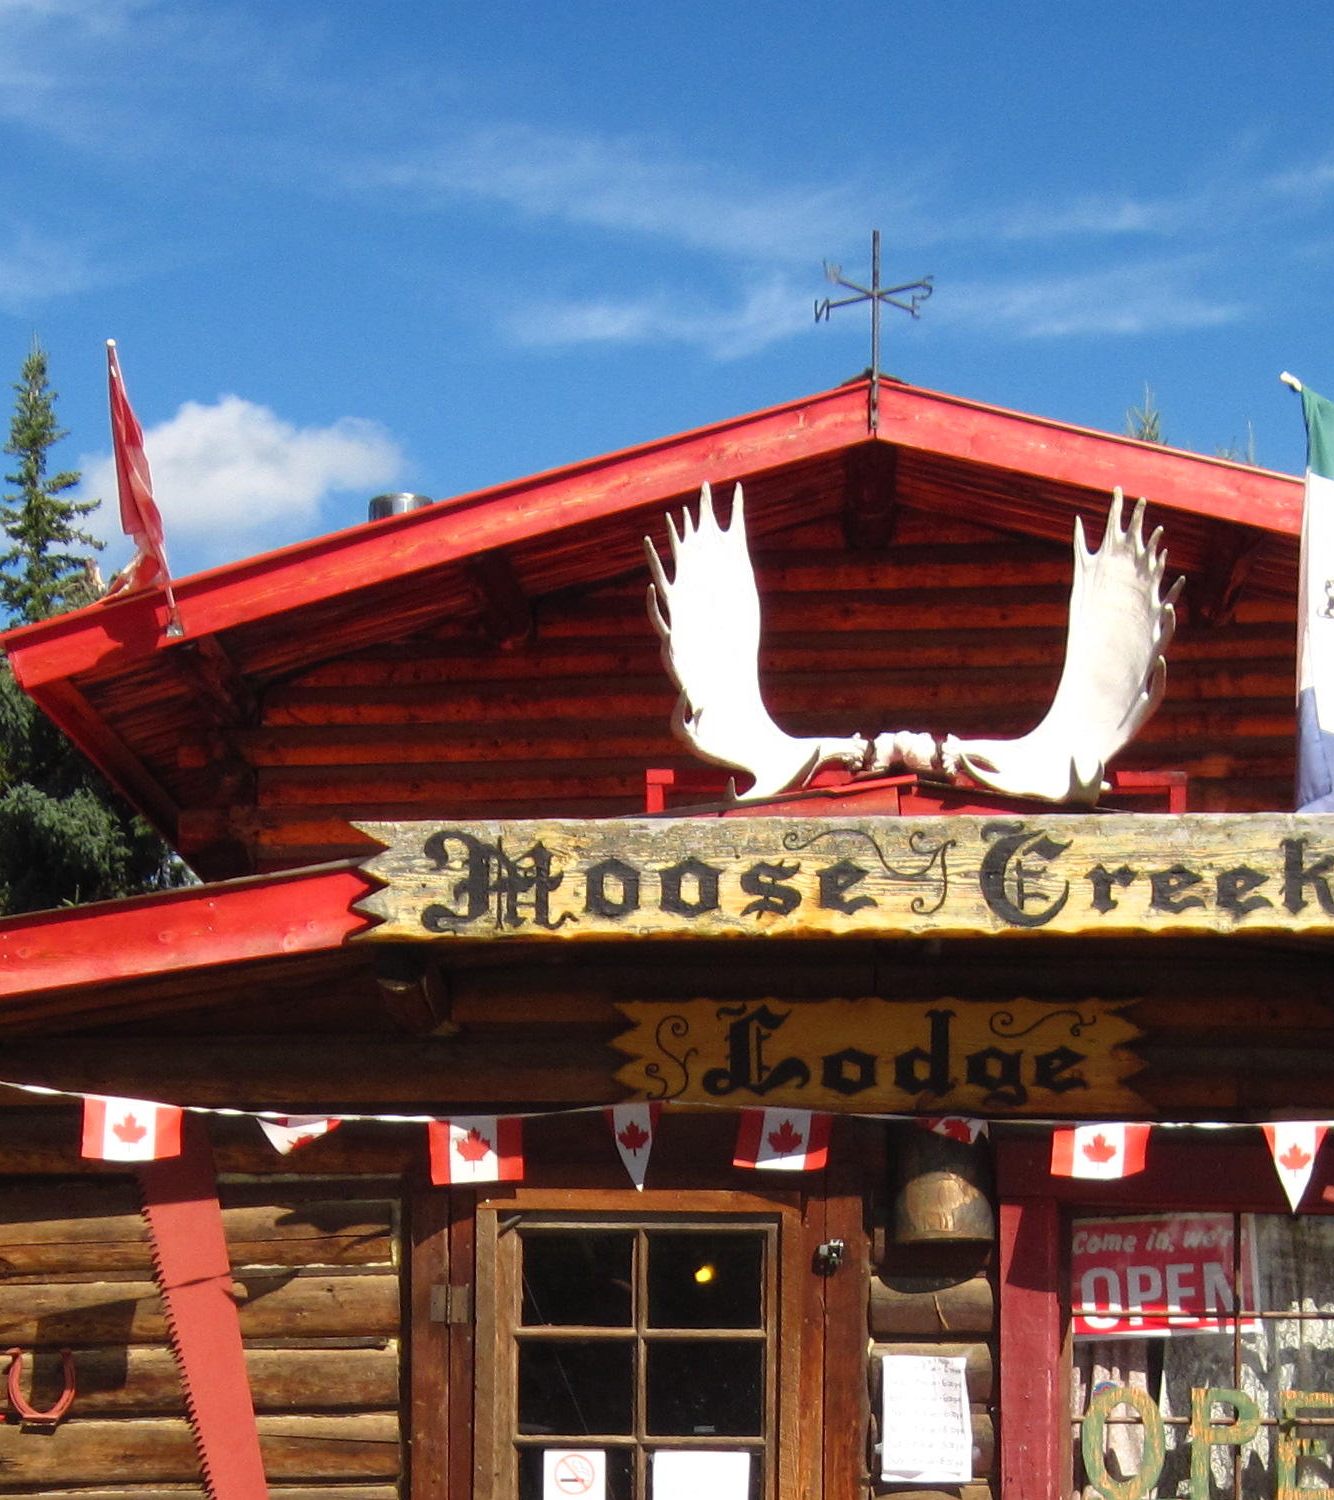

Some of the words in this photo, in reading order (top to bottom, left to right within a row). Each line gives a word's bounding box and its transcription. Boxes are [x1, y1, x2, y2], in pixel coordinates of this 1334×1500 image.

[421, 830, 878, 935] Moose
[702, 1002, 1088, 1106] Lodge
[1072, 1230, 1138, 1255] Come
[1081, 1261, 1239, 1330] OPEN
